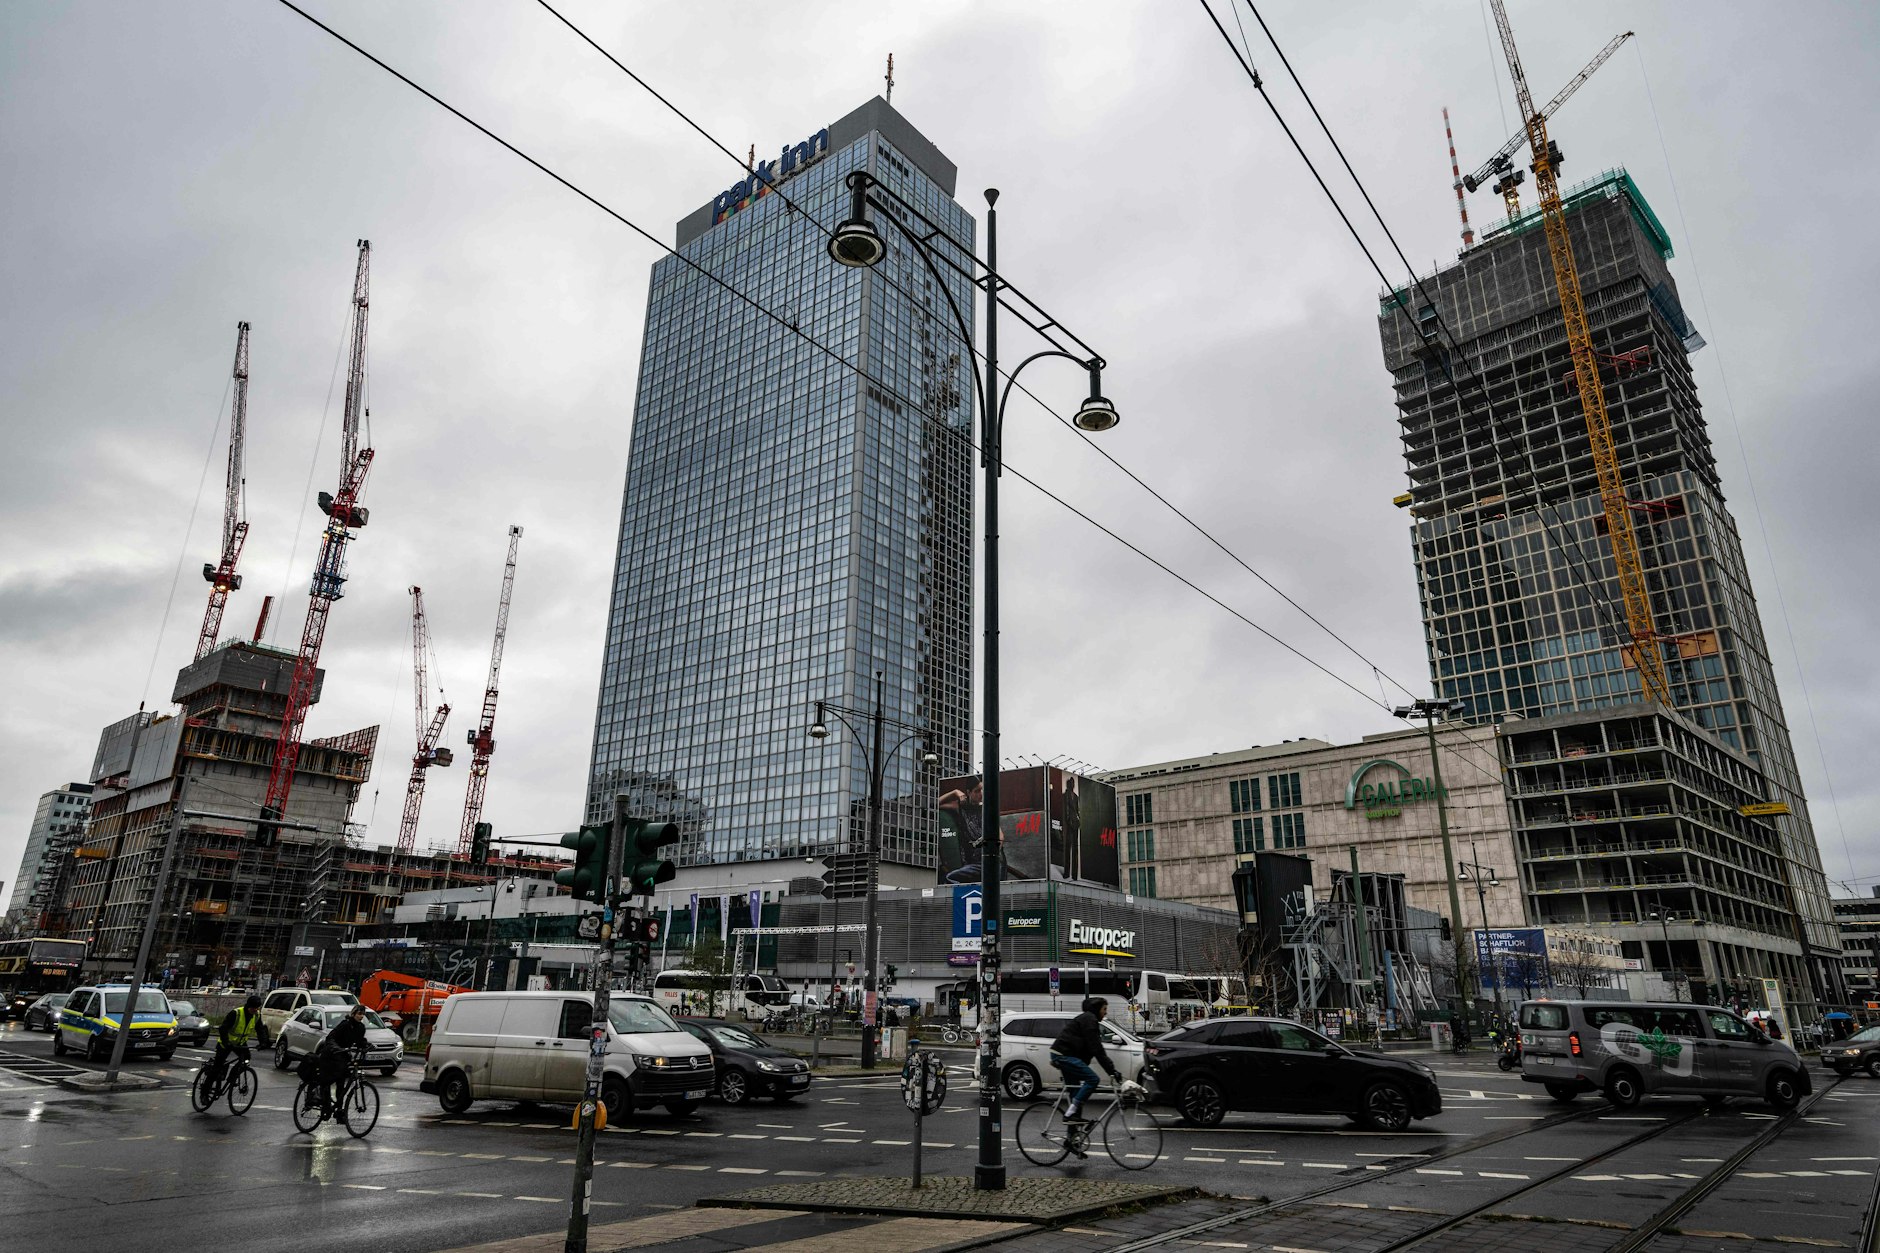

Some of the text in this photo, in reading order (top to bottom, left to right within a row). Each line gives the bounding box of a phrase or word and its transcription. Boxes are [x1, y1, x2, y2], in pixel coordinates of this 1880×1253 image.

[712, 160, 776, 225] park
[780, 129, 828, 175] inn
[965, 896, 982, 934] P
[1008, 917, 1041, 927] Europcar
[1069, 918, 1136, 955] Europcar
